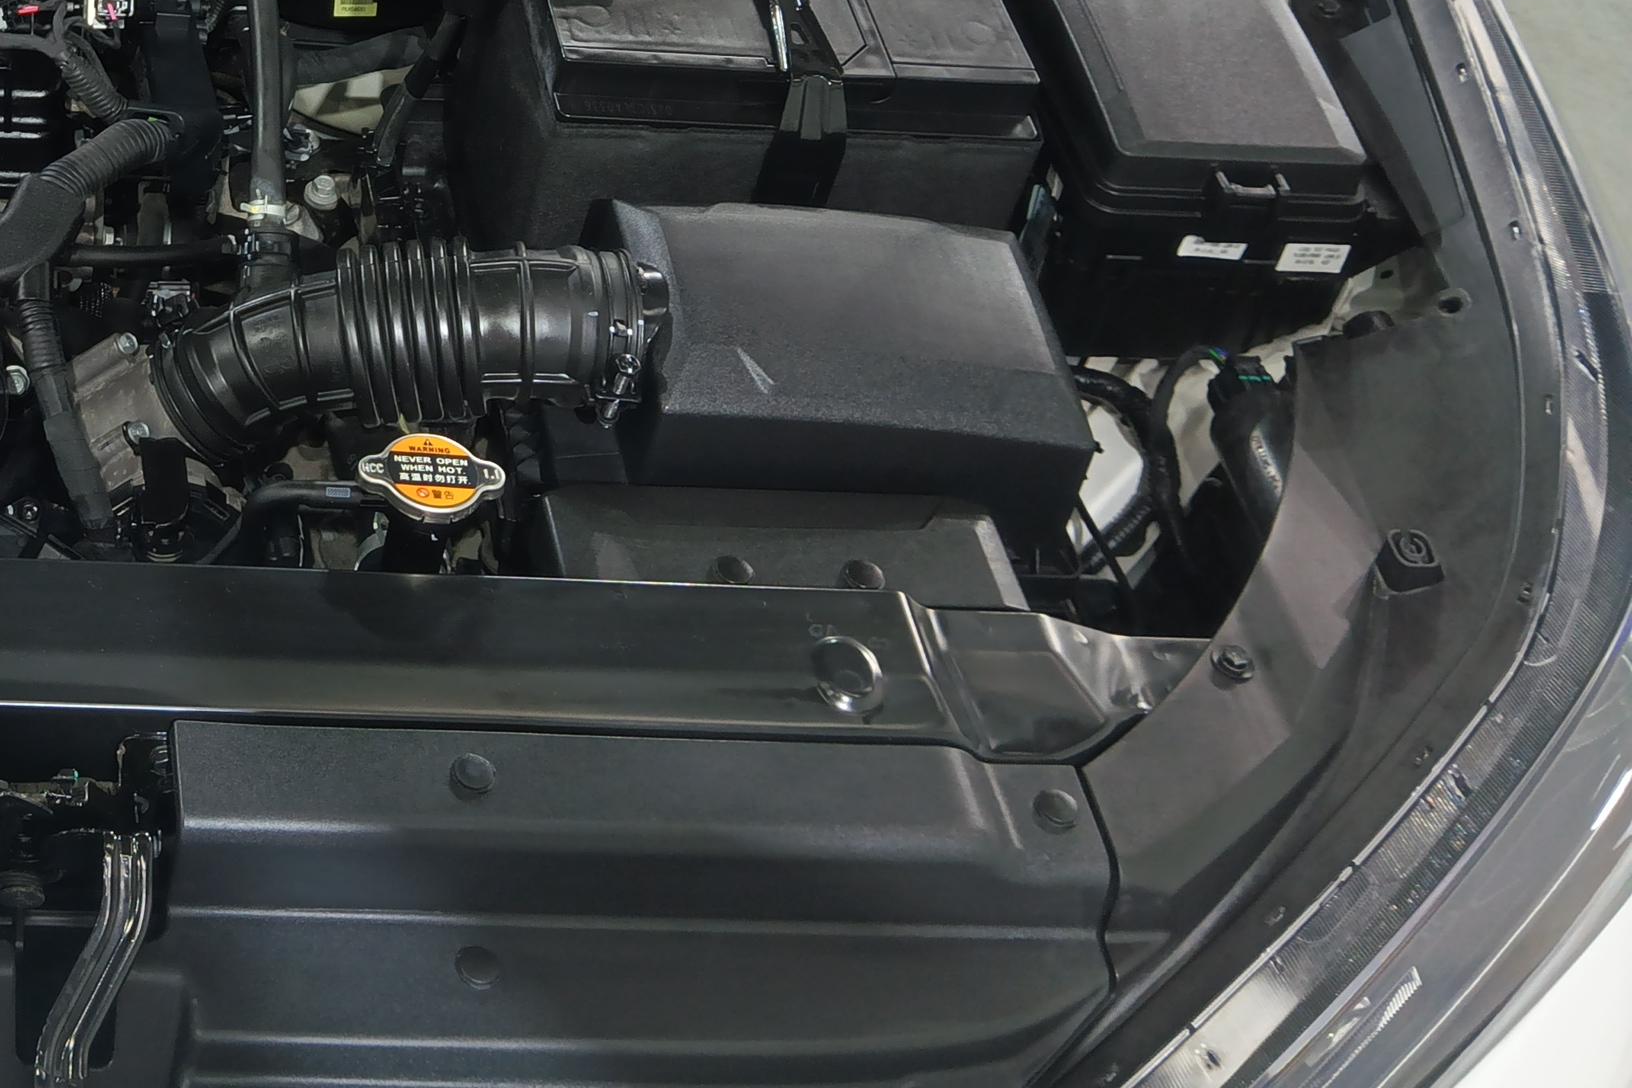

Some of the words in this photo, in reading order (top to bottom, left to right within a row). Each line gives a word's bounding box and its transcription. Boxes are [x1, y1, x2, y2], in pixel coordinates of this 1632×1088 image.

[408, 445, 451, 454] WARNING
[394, 454, 432, 464] NEVER
[436, 457, 468, 466] OPEN
[362, 462, 384, 474] HCC
[400, 463, 434, 472] WHEN
